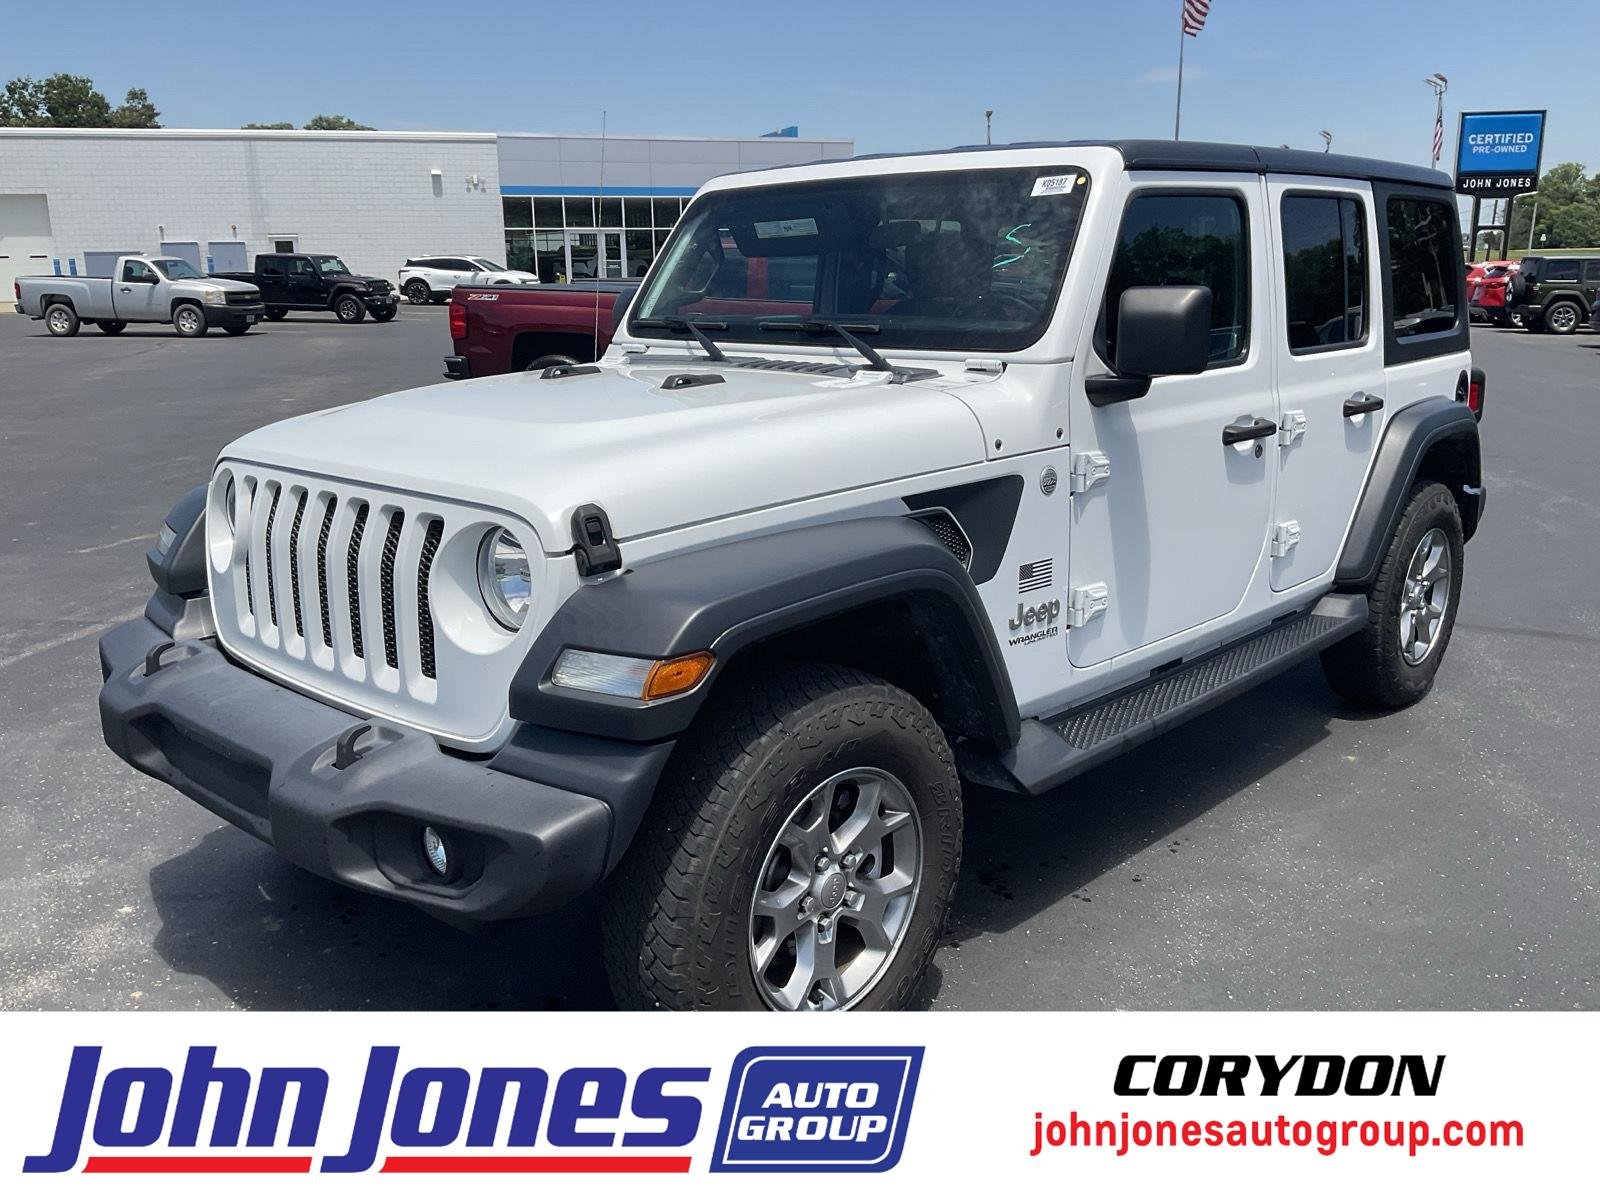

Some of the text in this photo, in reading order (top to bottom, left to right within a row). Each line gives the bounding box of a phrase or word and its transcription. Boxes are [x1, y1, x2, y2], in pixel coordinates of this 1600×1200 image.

[1468, 133, 1534, 144] CERTIFIED
[1472, 145, 1528, 154] PRE-OWNED
[1463, 178, 1531, 188] JOHN JONES
[467, 293, 500, 301] Z71
[1008, 598, 1060, 631] Jeep
[1008, 626, 1058, 647] WRANGLER
